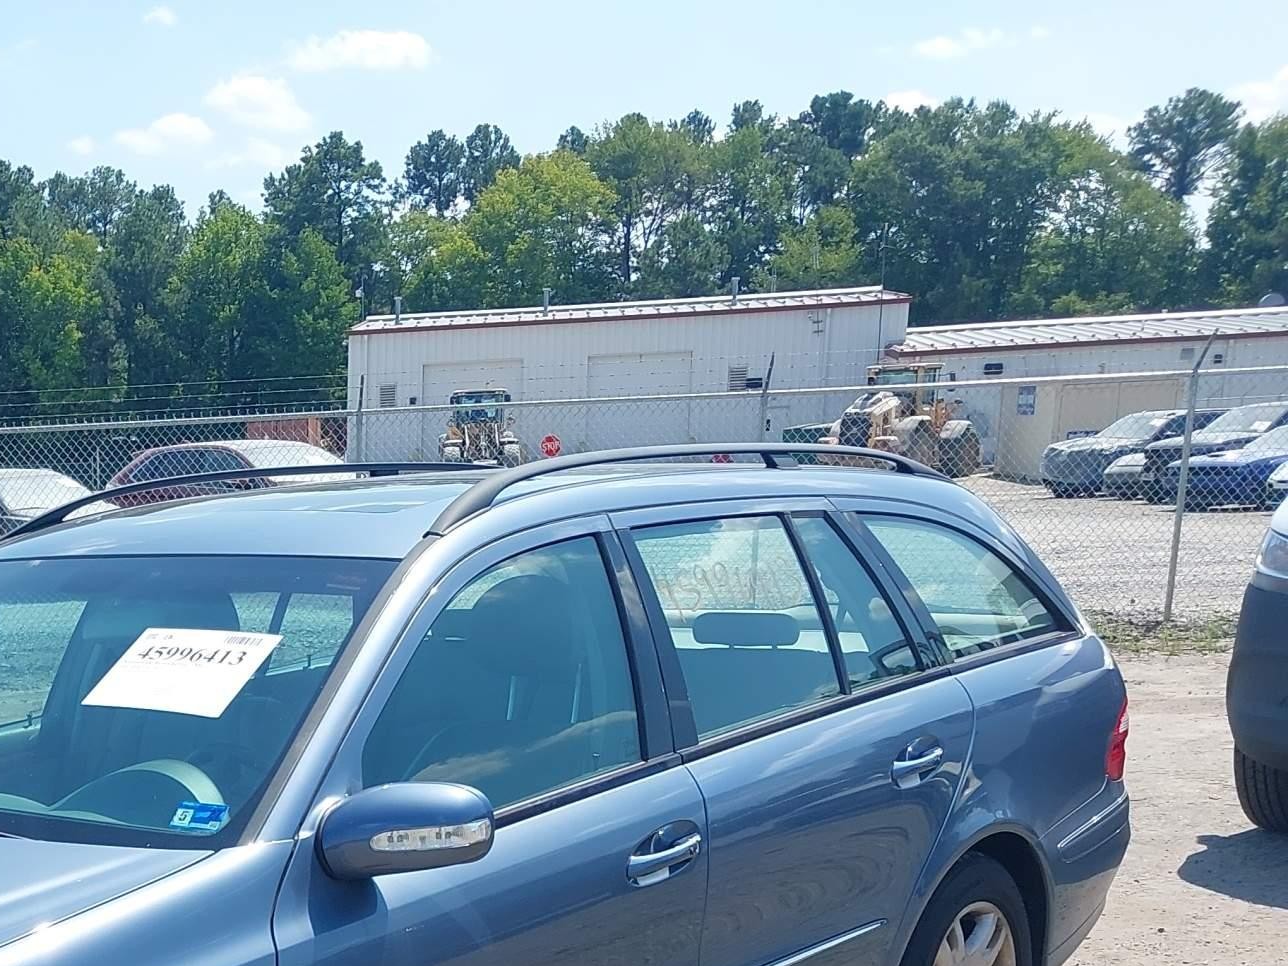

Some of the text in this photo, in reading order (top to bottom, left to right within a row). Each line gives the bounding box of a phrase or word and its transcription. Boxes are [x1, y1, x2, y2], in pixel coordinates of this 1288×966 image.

[542, 441, 560, 453] STOP
[137, 646, 247, 666] 45996413
[178, 810, 190, 822] 5
